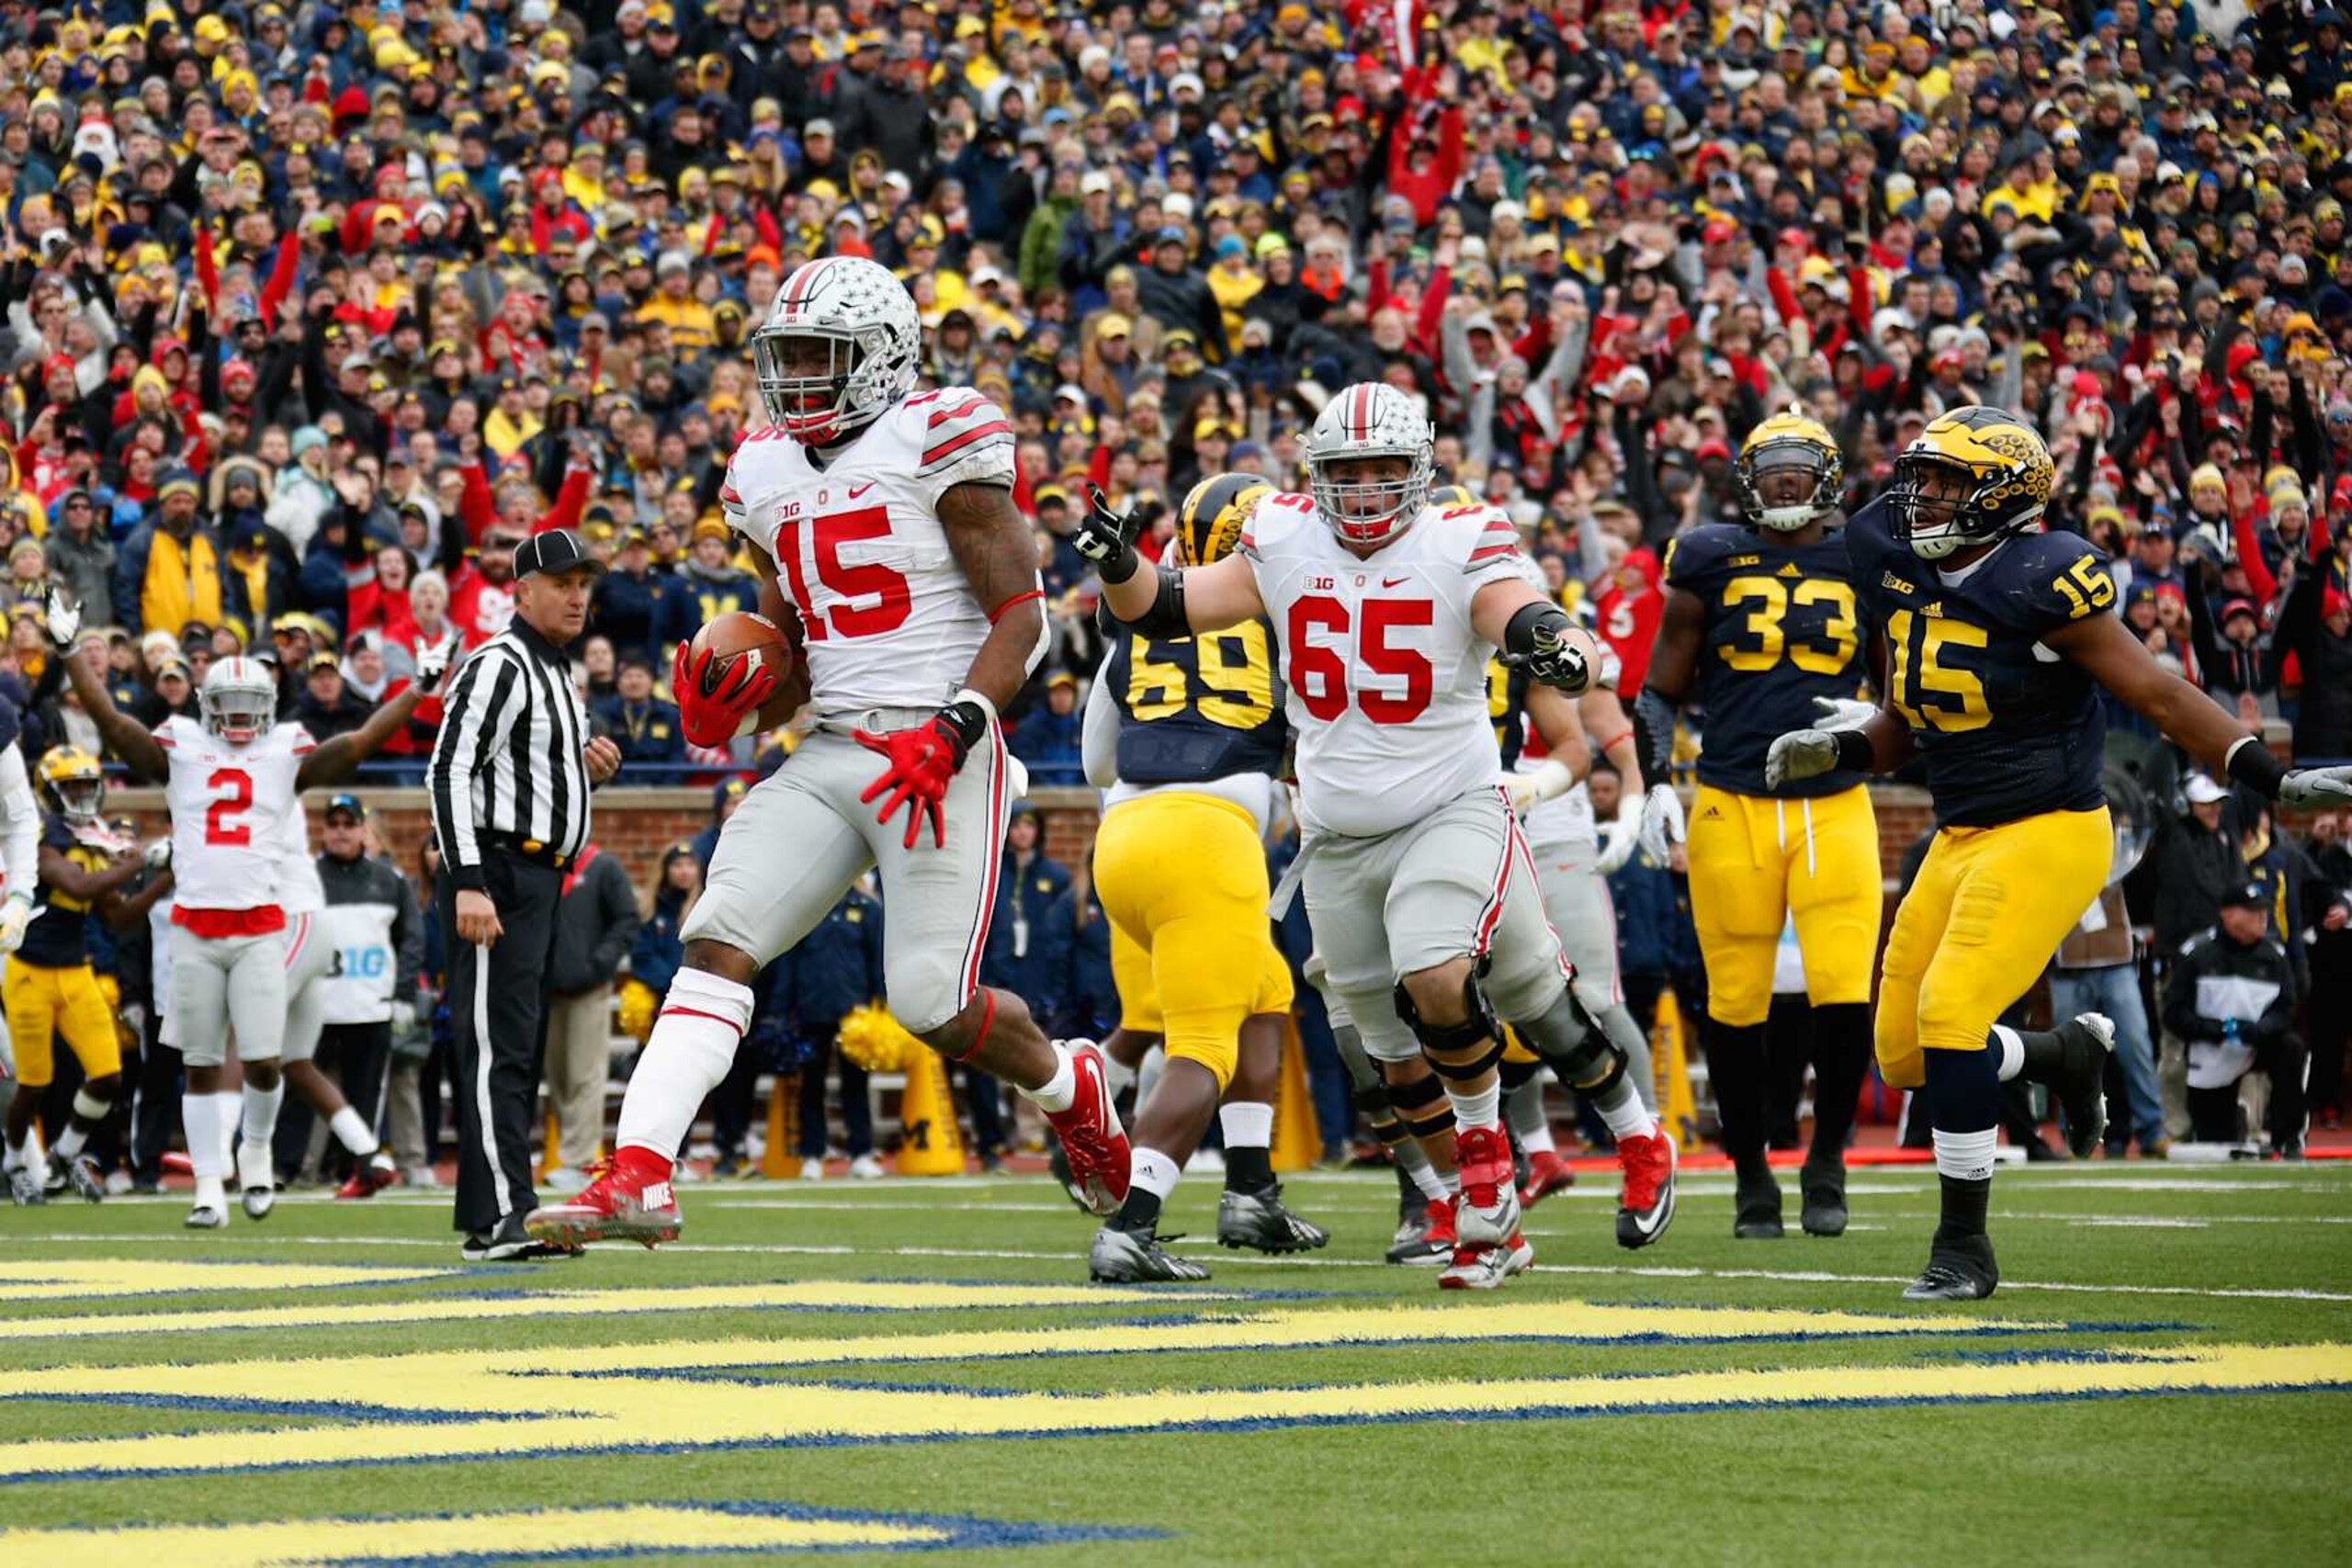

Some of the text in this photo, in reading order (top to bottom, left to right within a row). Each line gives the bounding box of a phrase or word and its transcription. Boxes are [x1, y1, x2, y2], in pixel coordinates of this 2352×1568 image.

[776, 506, 912, 640] 15
[1717, 576, 1859, 675] 33
[2052, 554, 2115, 618] 15
[1125, 618, 1274, 729] 69
[1288, 595, 1433, 724] 65
[1888, 609, 1993, 732] 15
[205, 768, 253, 846] 2
[642, 1181, 673, 1212] NIKE
